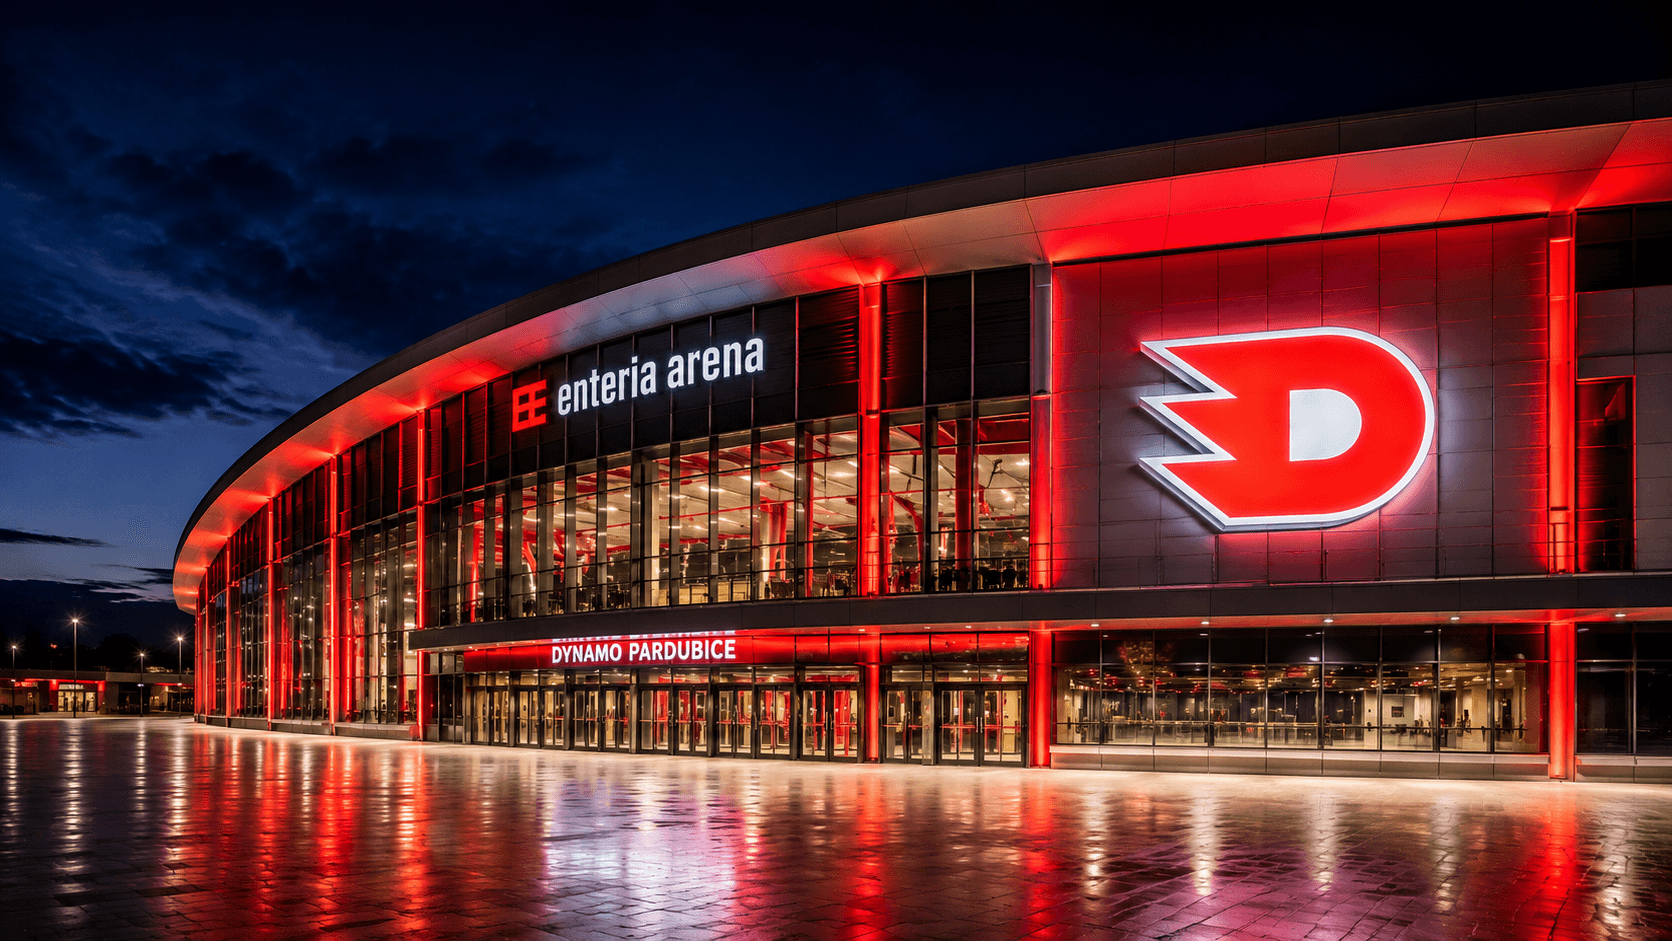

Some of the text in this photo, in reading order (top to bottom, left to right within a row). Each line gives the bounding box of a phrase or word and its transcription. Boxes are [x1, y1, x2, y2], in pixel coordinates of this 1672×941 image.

[557, 337, 764, 416] enteria arena
[551, 639, 736, 664] DYNAMO PARDUBICE
